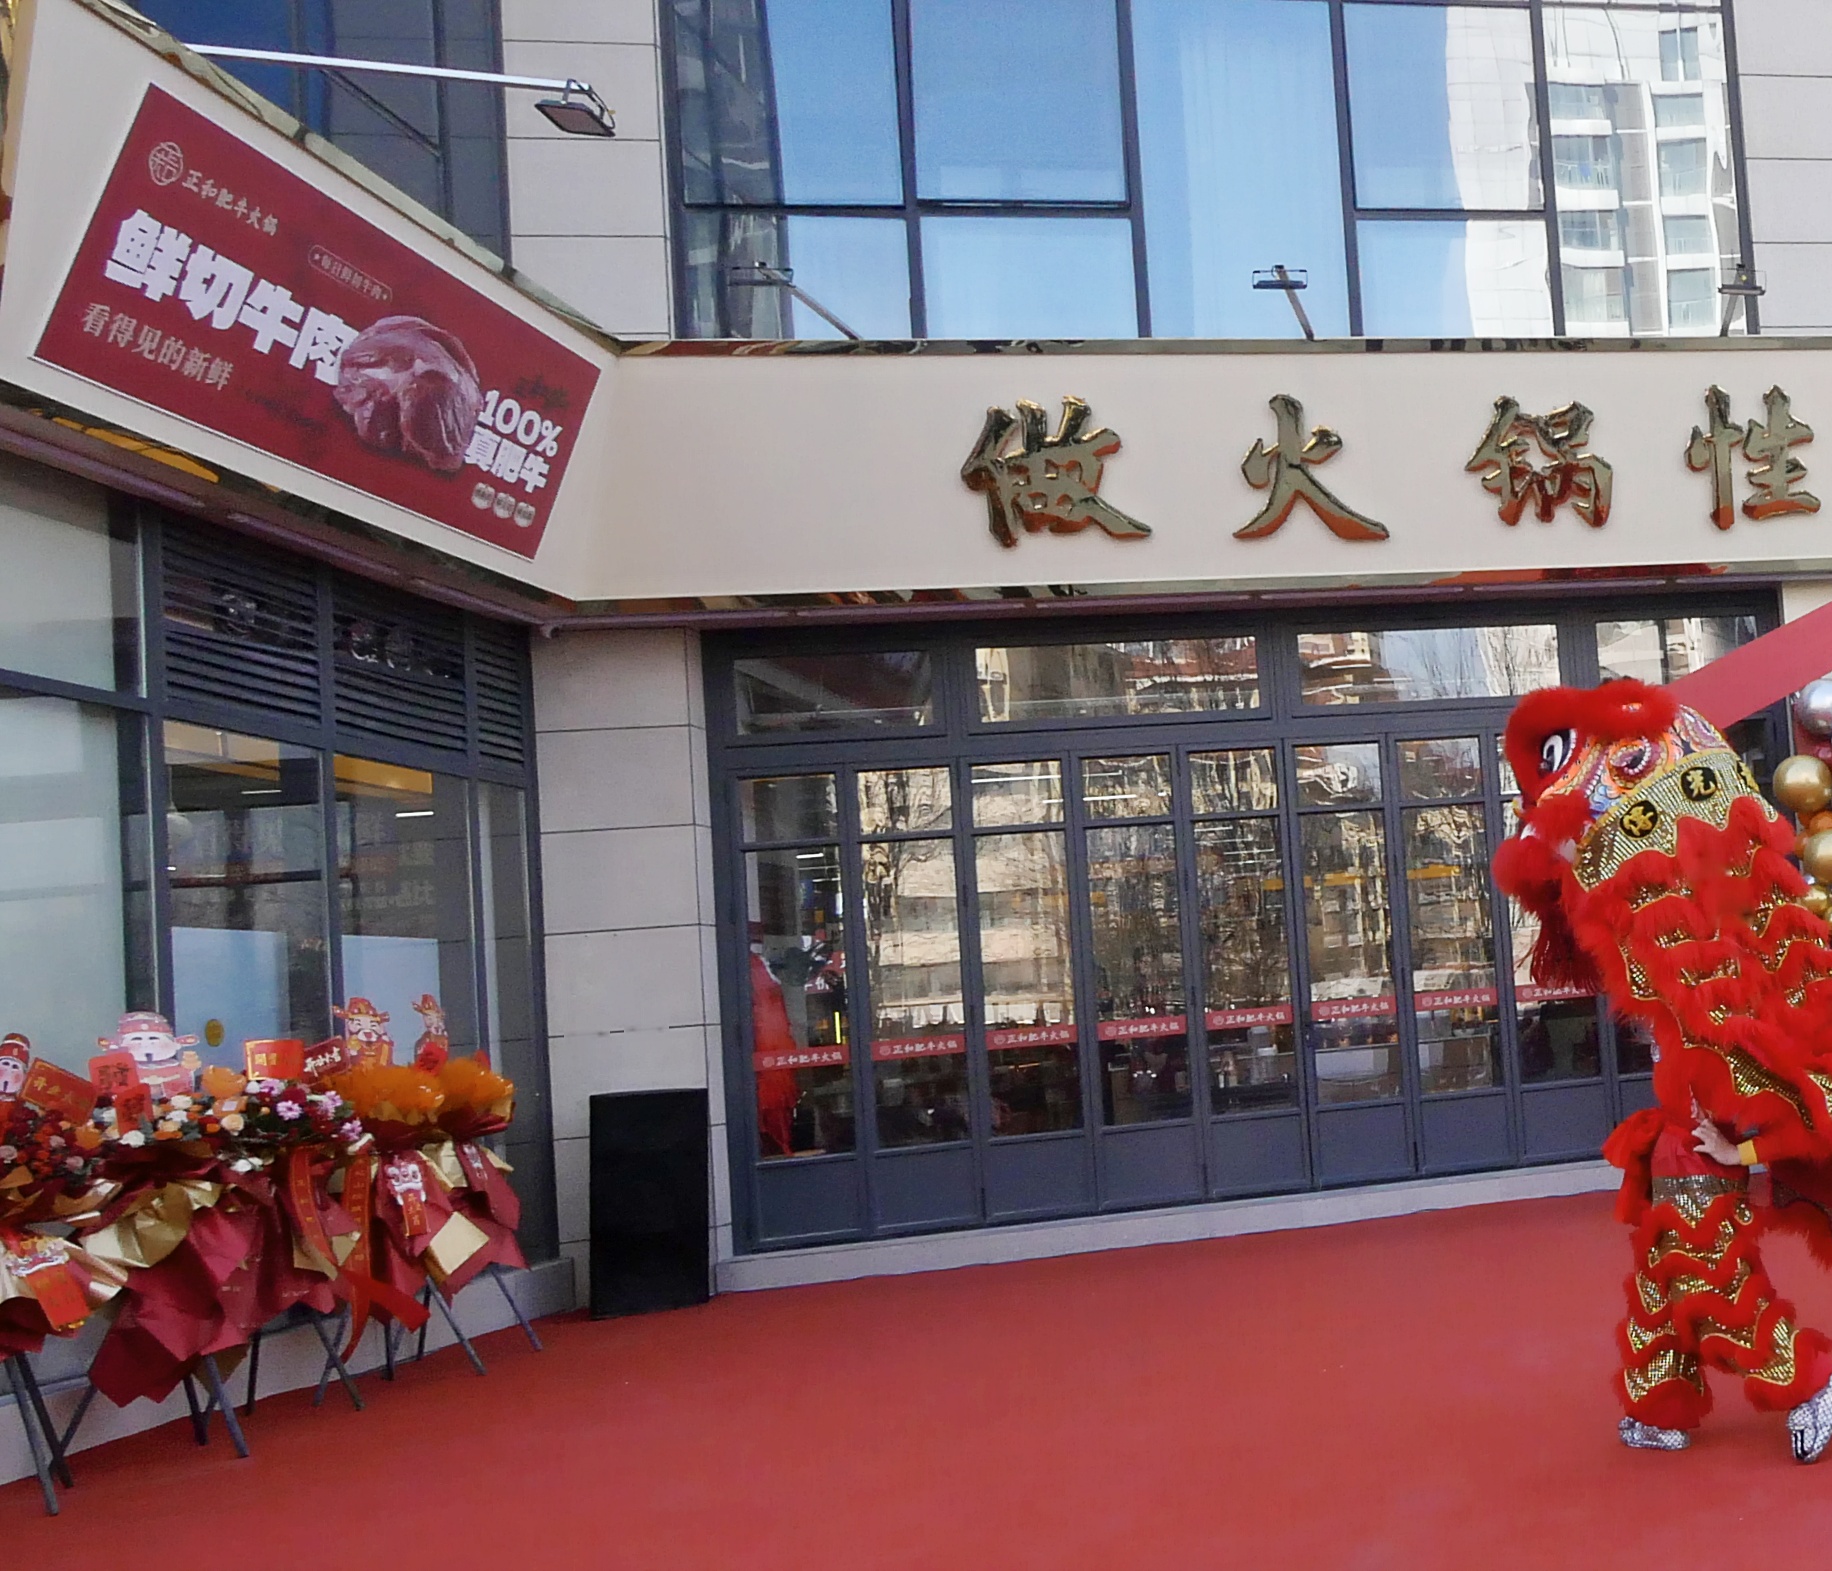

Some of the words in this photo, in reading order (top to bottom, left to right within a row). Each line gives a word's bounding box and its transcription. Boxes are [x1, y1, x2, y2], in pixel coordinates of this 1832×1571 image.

[182, 169, 279, 236] 正和肥牛火锅
[104, 208, 360, 387] 鲜切牛肉
[82, 302, 233, 391] 看得见的新鲜
[478, 389, 563, 457] 100%
[464, 424, 550, 494] 真肥牛
[1433, 993, 1491, 1006] 正和肥牛火锅
[1331, 1002, 1389, 1016] 正和肥牛火锅
[1225, 1011, 1286, 1025] 正和肥牛火锅
[1118, 1021, 1180, 1036] 正和肥牛火锅
[1007, 1030, 1070, 1044] 正和肥牛火锅
[892, 1039, 958, 1055] 正和肥牛火锅
[776, 1051, 843, 1066] 正和肥牛火锅
